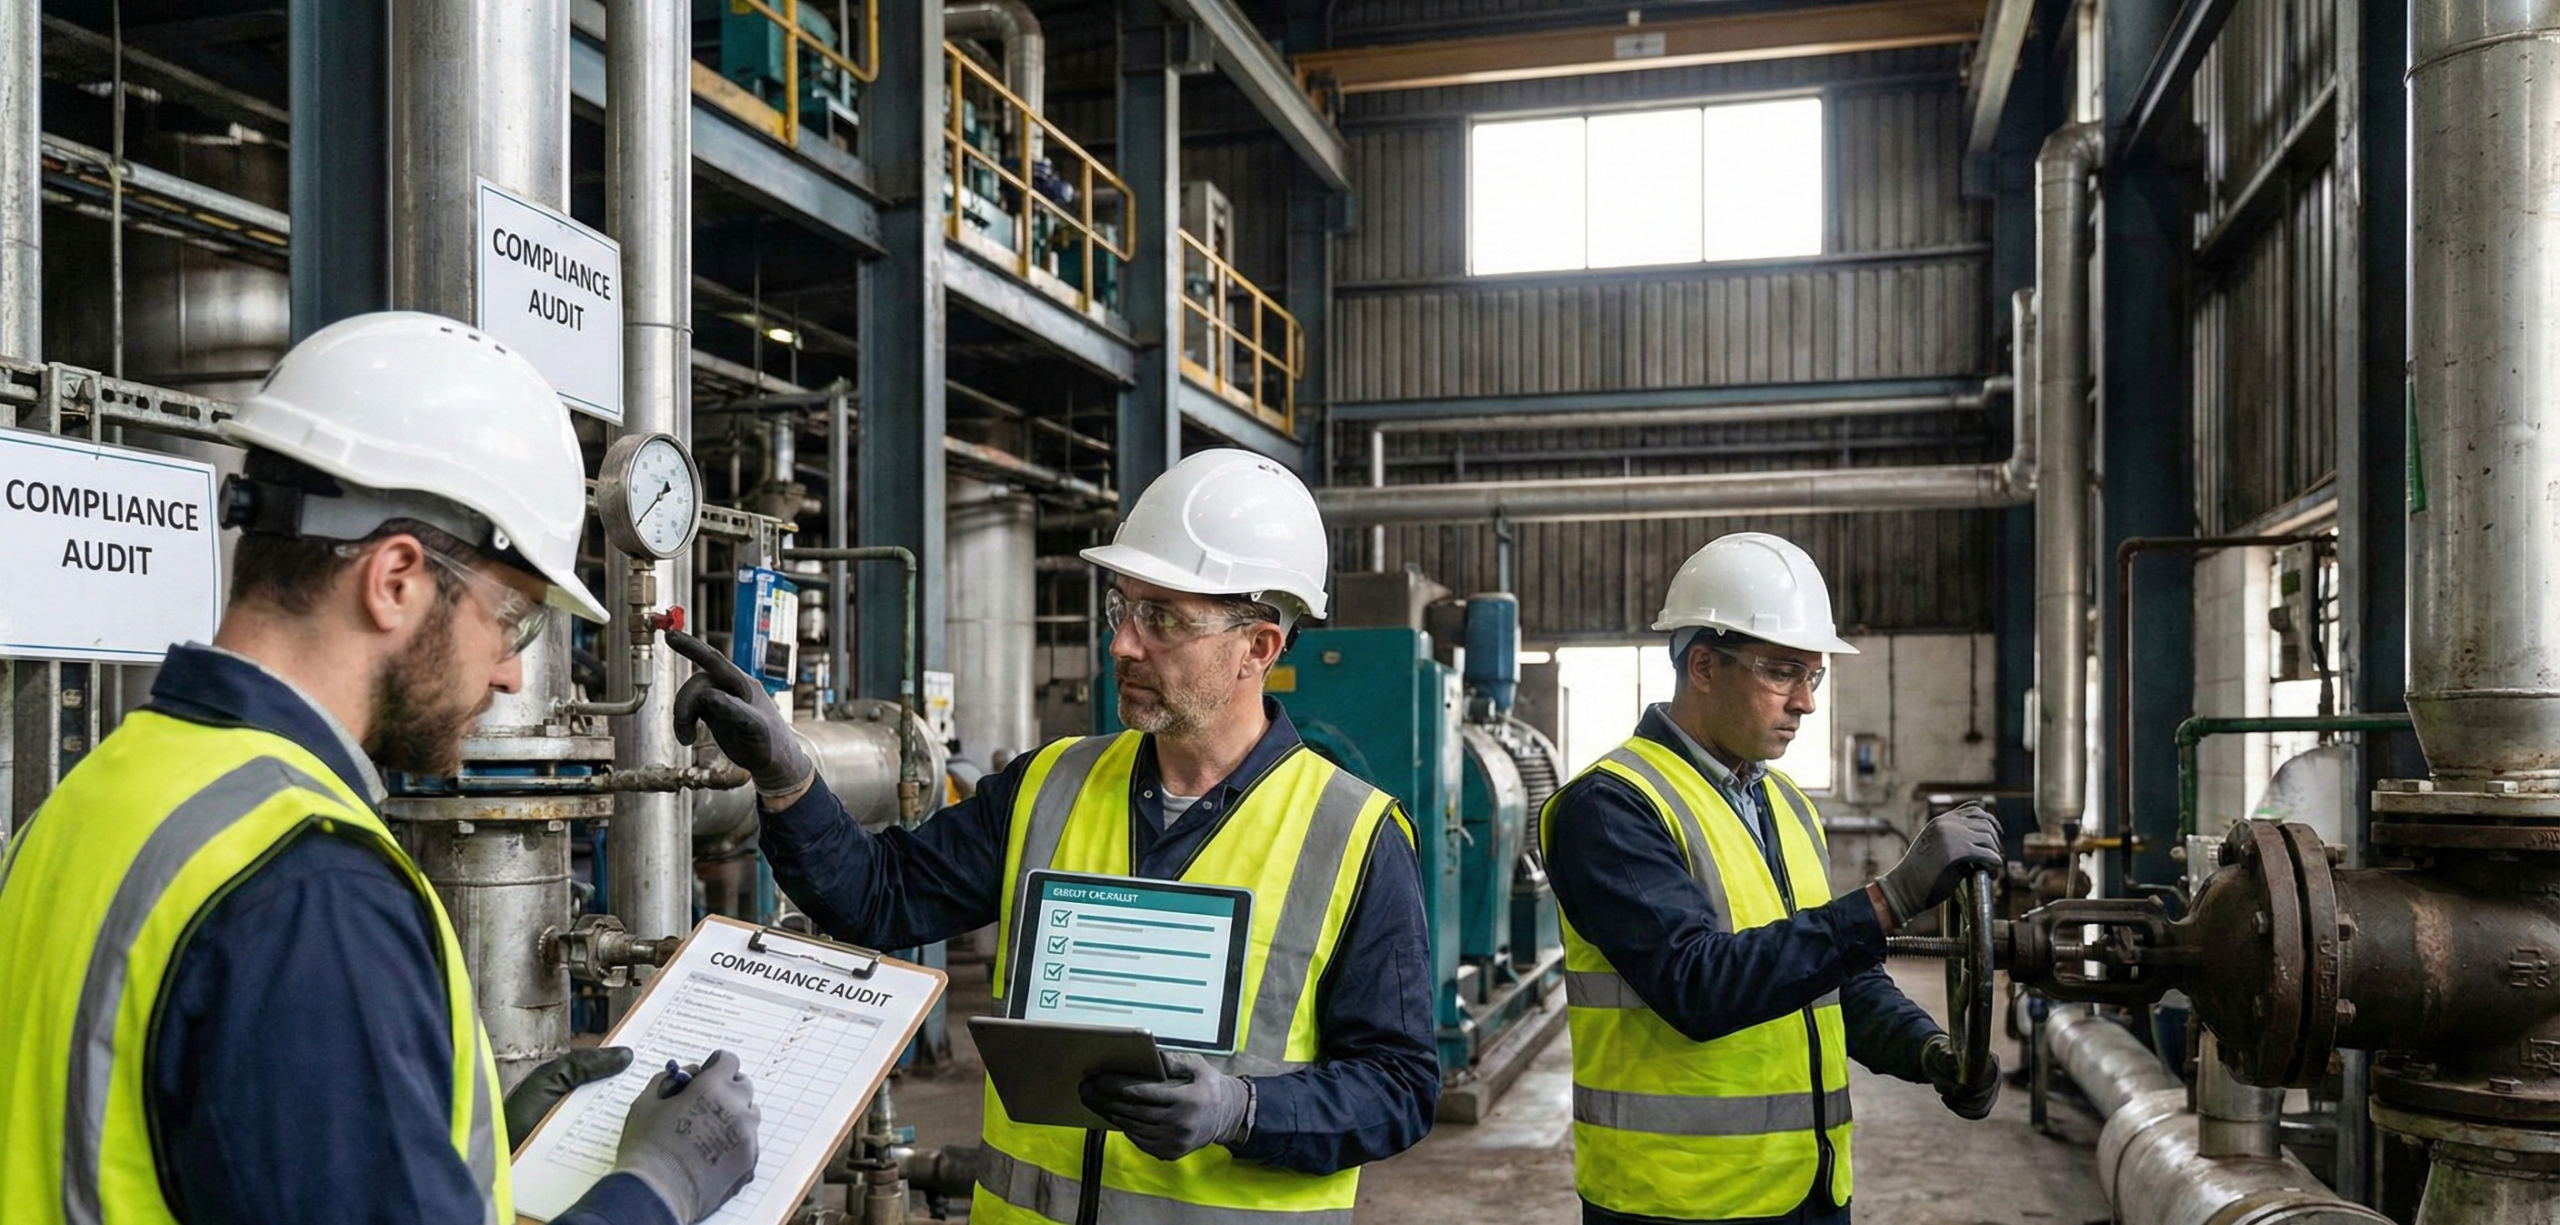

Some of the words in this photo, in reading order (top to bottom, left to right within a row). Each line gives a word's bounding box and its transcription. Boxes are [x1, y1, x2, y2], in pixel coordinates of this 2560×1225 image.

[492, 227, 611, 301] COMPLIANCE
[528, 288, 585, 332] AUDIT
[5, 478, 199, 532] COMPLIANCE
[61, 538, 153, 575] AUDIT
[709, 951, 830, 994] COMPLIANCE
[829, 982, 893, 1008] AUDIT
